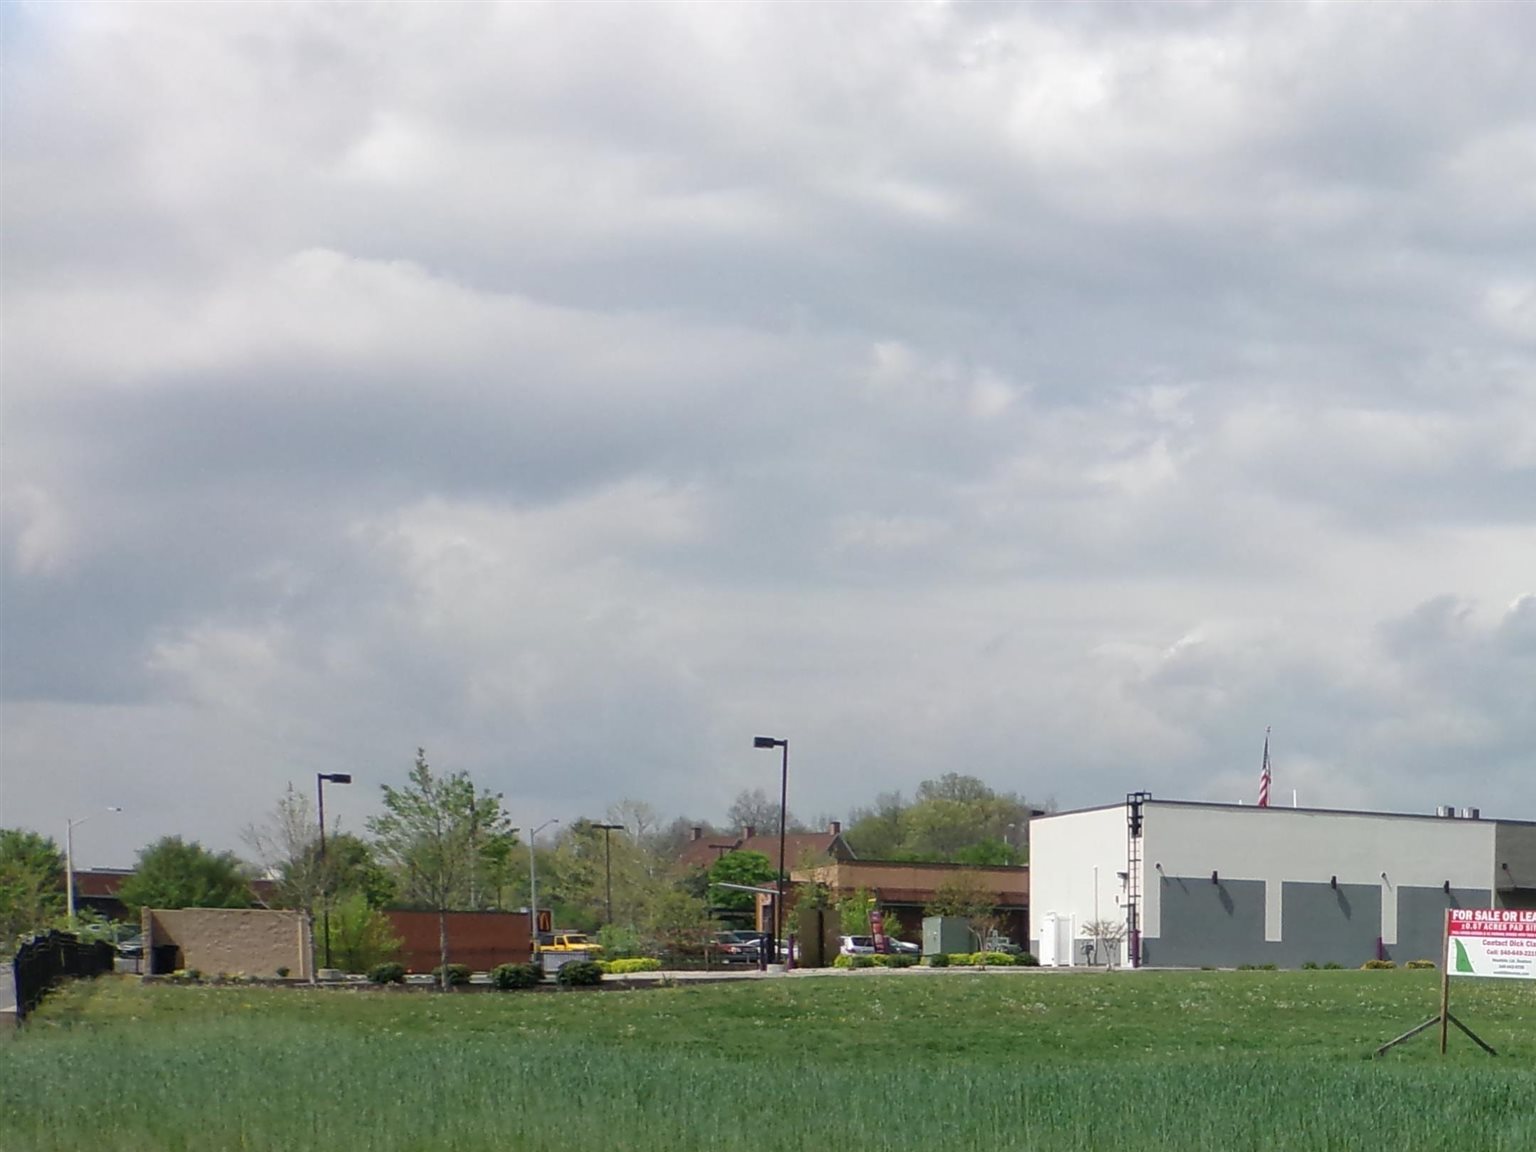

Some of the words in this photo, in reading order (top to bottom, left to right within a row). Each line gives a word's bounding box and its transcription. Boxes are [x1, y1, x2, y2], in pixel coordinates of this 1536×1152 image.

[1452, 909, 1473, 921] FOR
[1474, 910, 1501, 921] SALE
[1502, 911, 1518, 922] OR
[1483, 923, 1507, 932] ACRES
[1510, 924, 1524, 932] PAD
[1482, 939, 1508, 947] Contact
[1509, 940, 1524, 948] Dick
